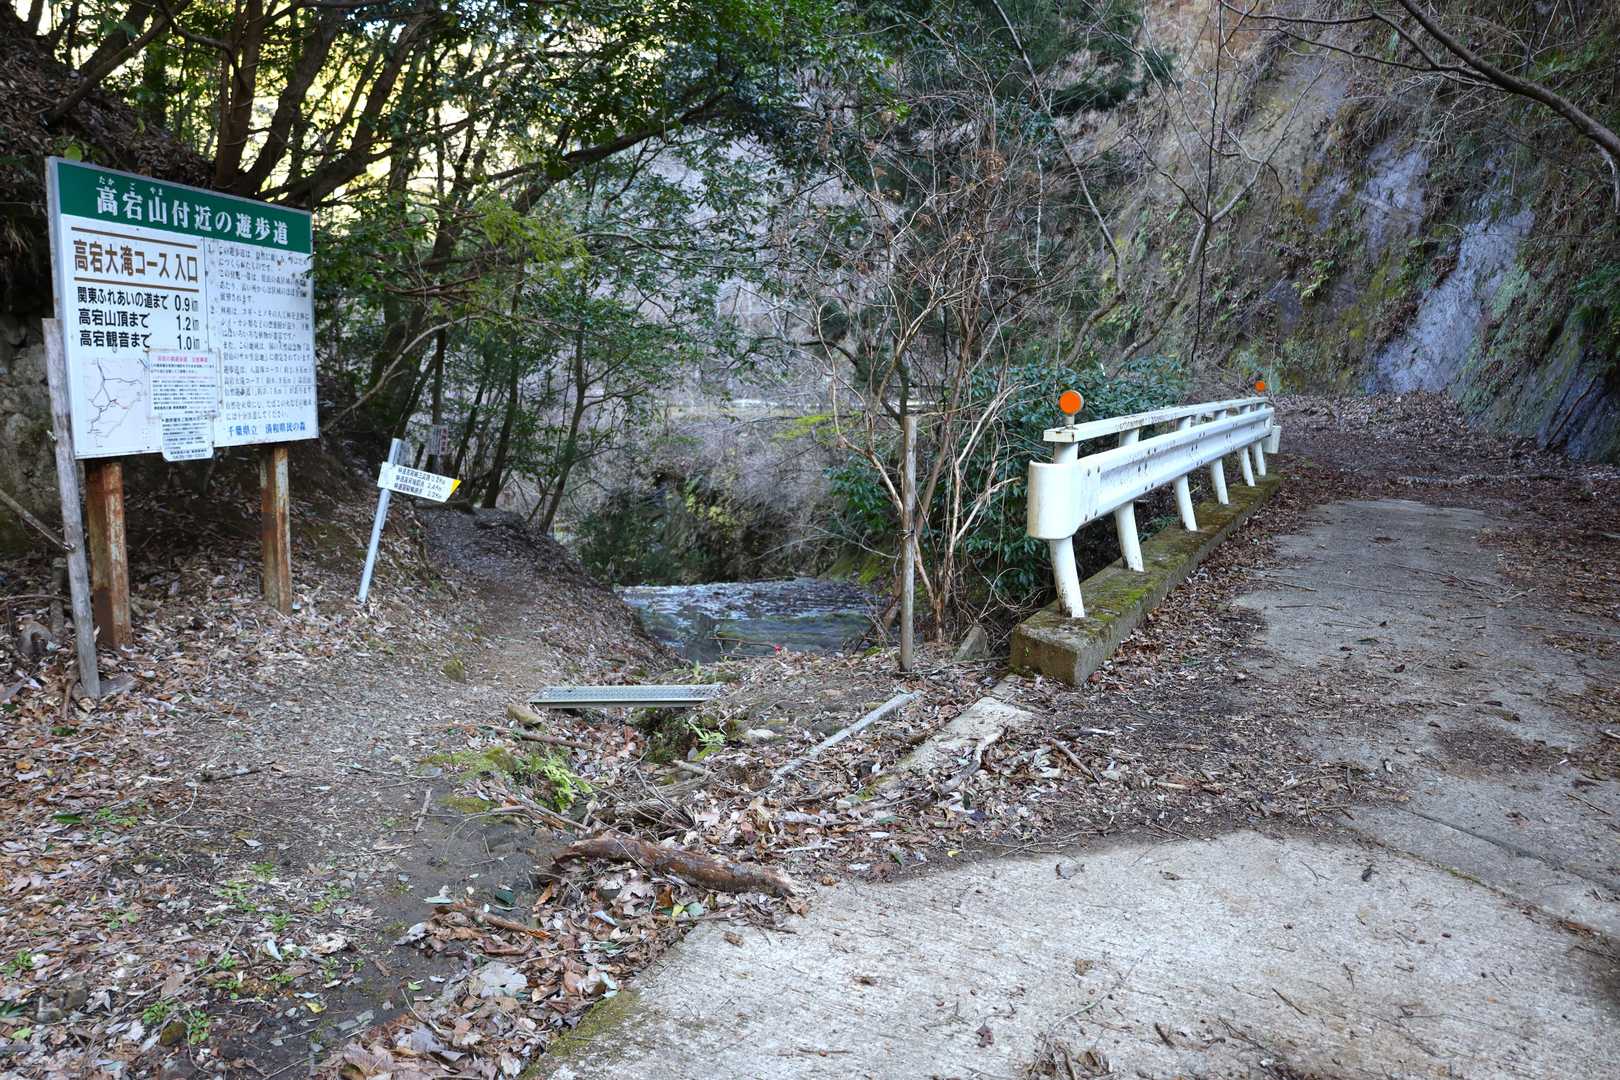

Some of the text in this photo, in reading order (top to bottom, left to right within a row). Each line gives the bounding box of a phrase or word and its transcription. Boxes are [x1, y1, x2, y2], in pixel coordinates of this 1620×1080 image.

[96, 185, 289, 245] 高宕山付近の遊歩道
[73, 239, 198, 283] 高宕大滝コース入口
[77, 286, 168, 310] 関東ふれあいの道まで
[78, 308, 150, 328] 高宕山頂まで
[80, 330, 152, 348] 高宕観音まで
